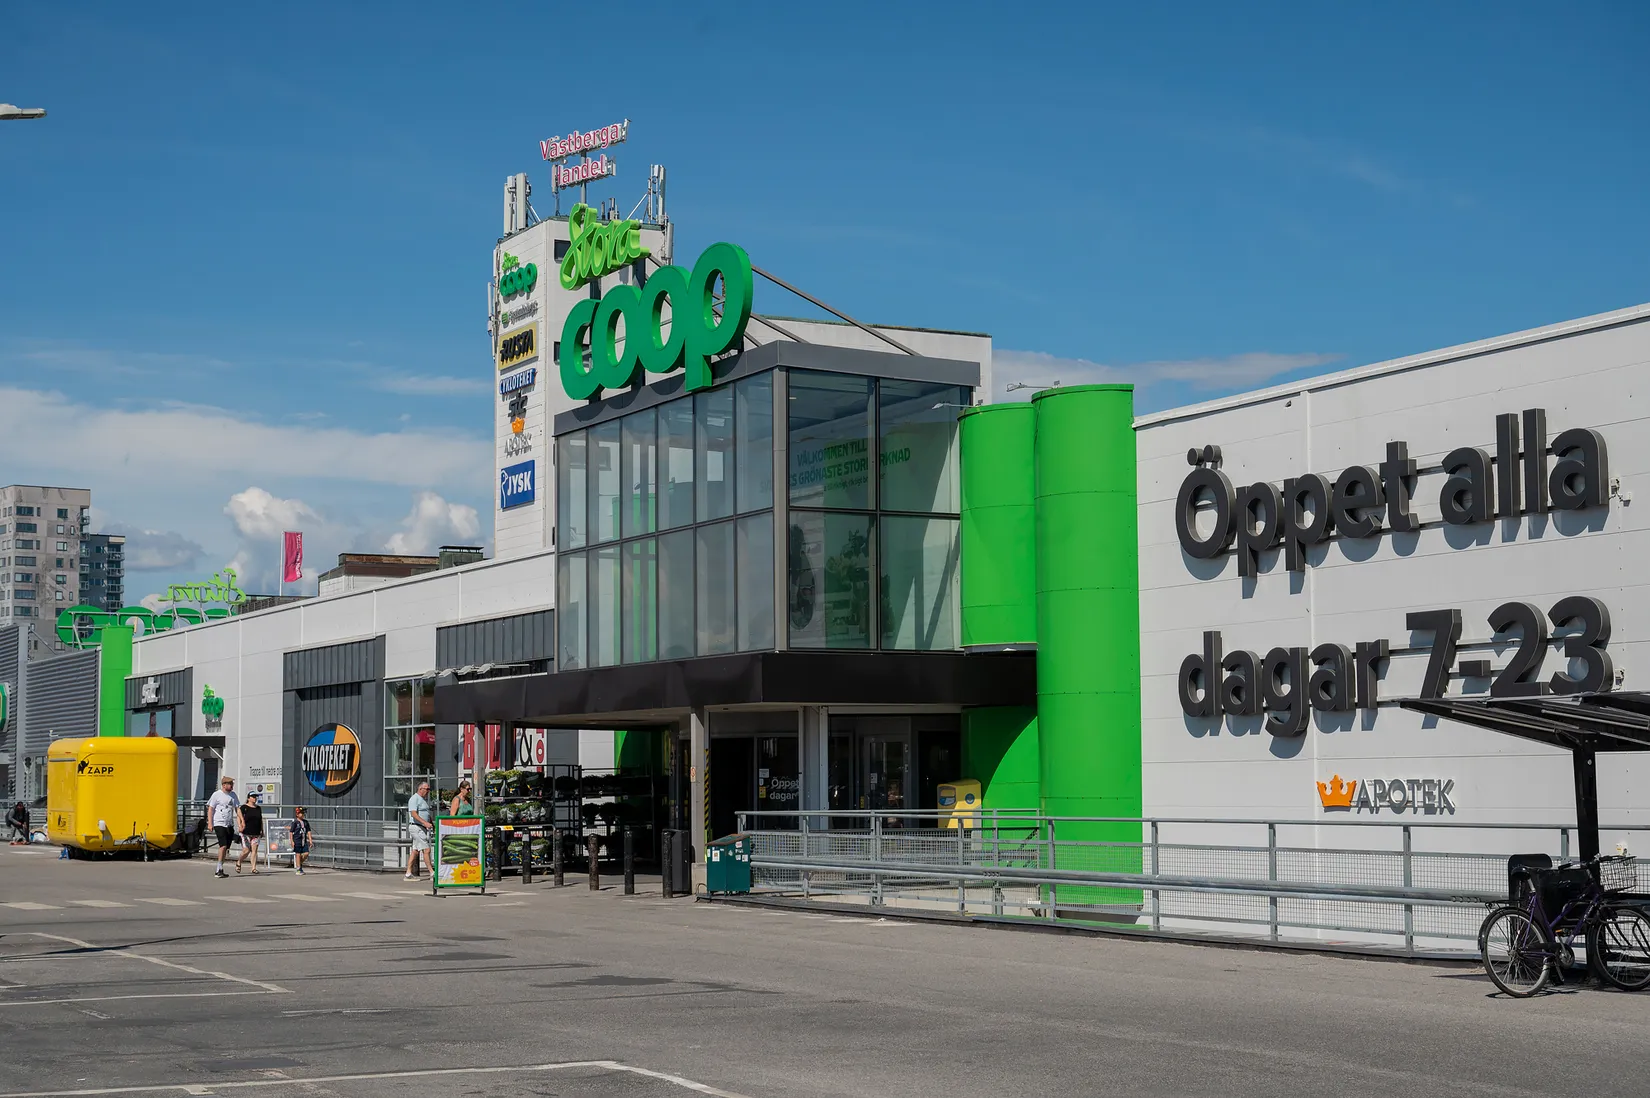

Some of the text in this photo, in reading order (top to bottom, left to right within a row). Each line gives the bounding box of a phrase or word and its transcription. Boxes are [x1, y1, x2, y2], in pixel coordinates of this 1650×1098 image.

[540, 123, 620, 160] Västberga
[560, 203, 651, 290] Stora
[500, 263, 537, 297] coop
[560, 242, 753, 400] coop
[500, 329, 533, 362] RUSTA
[500, 369, 534, 394] CYKLOTEKET
[797, 440, 867, 467] VÄLKOMMEN TILL
[507, 470, 532, 496] JYSK
[1176, 408, 1609, 577] Öppet alla
[1179, 596, 1612, 736] dagar 7-23
[88, 766, 114, 774] ZAPP
[301, 744, 351, 771] CYKLOTEKET
[1356, 779, 1456, 808] APOTEK
[460, 870, 468, 879] 6
